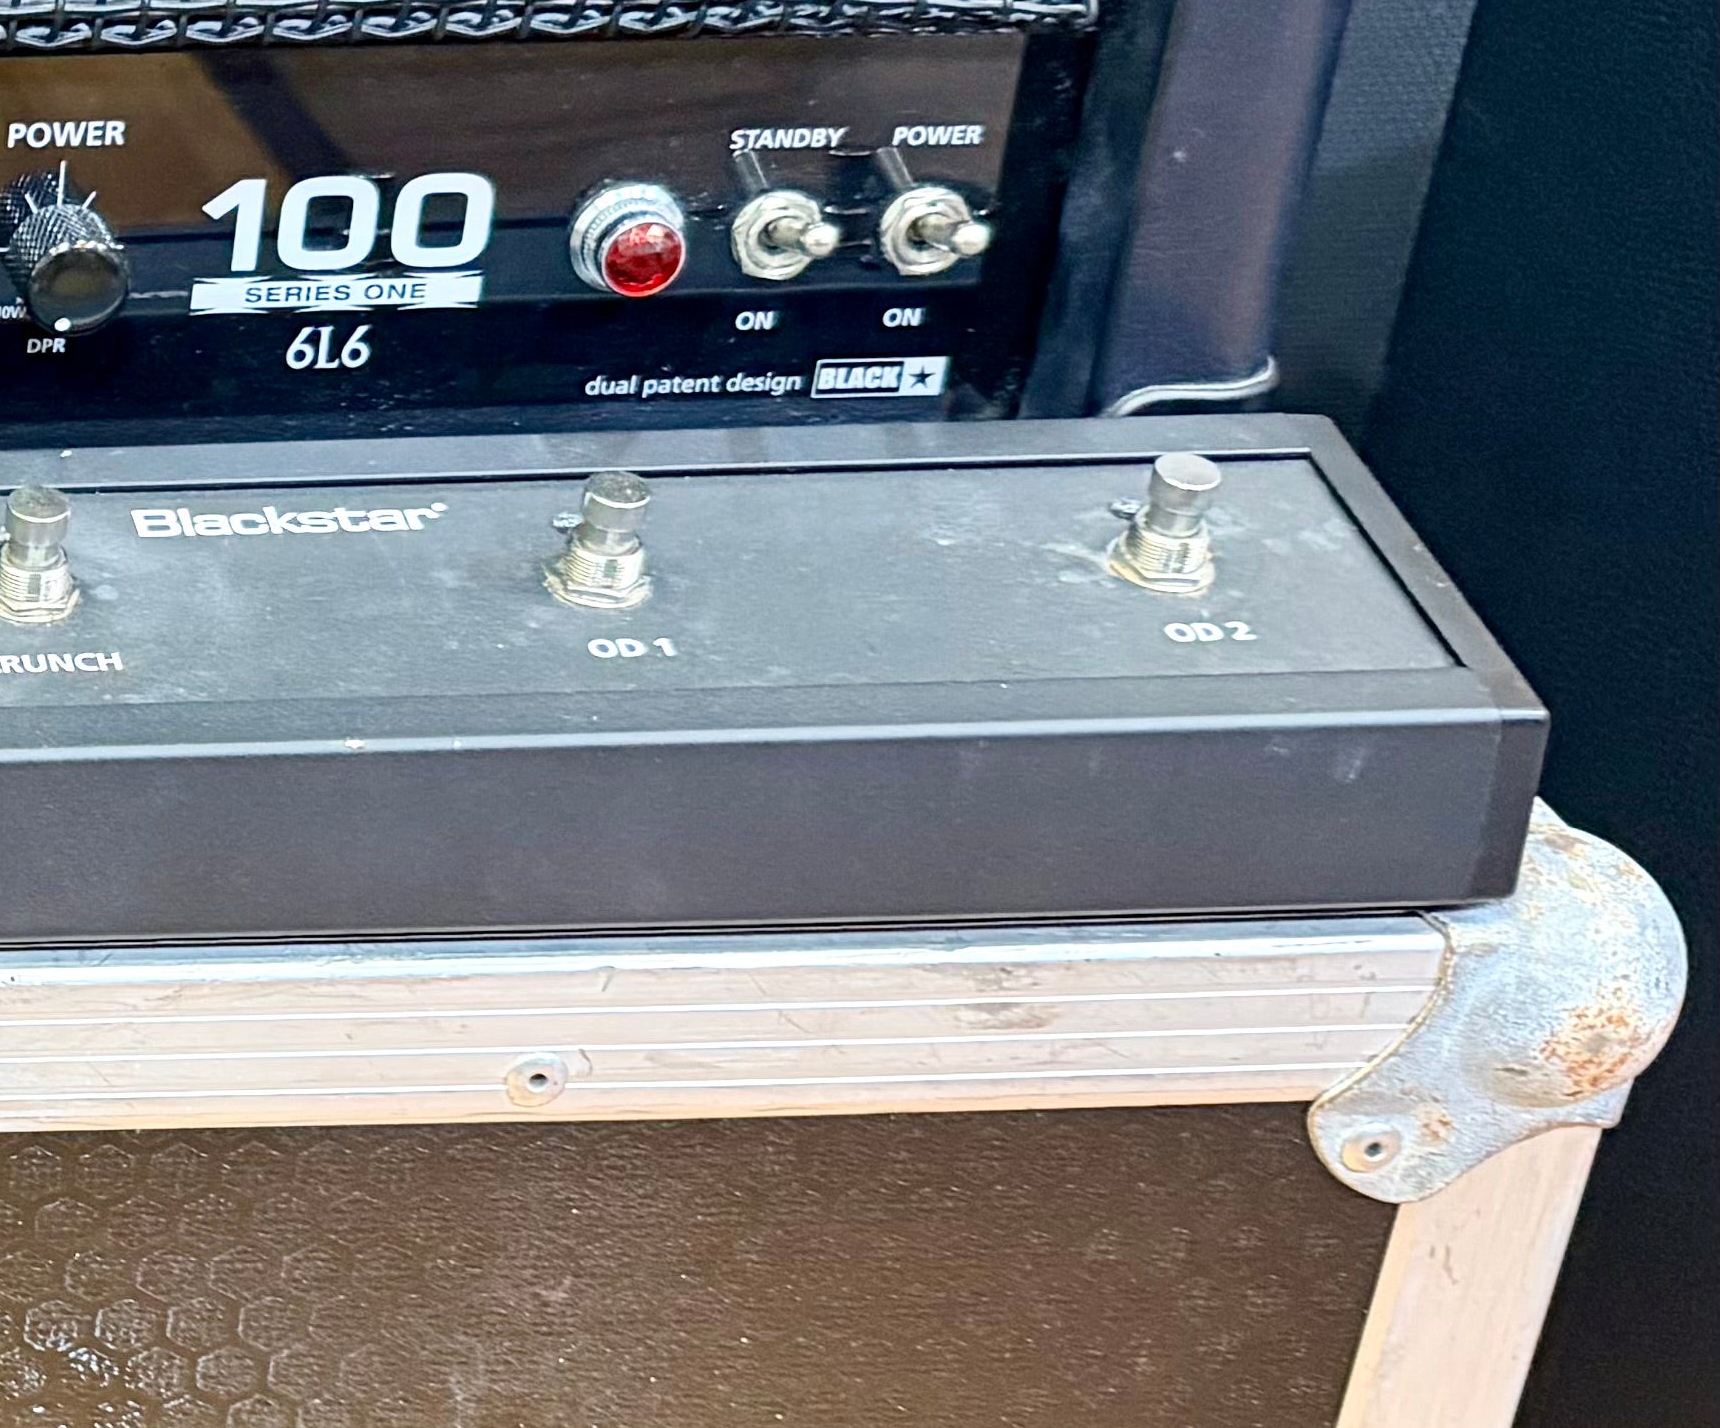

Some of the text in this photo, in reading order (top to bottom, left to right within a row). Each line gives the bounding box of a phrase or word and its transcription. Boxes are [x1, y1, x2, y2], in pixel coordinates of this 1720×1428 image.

[7, 120, 126, 149] POWER
[729, 126, 849, 150] STANDBY
[892, 124, 985, 147] POWER
[201, 172, 497, 272] 100
[245, 282, 428, 305] SERIES ONE
[735, 310, 775, 332] ON
[882, 307, 923, 328] ON
[27, 337, 67, 354] DPR
[285, 324, 374, 370] 6L6
[584, 365, 904, 399] dual patent design BLACK
[130, 505, 437, 539] Blackstar
[1163, 620, 1258, 642] OD 2
[587, 637, 678, 659] OD 1
